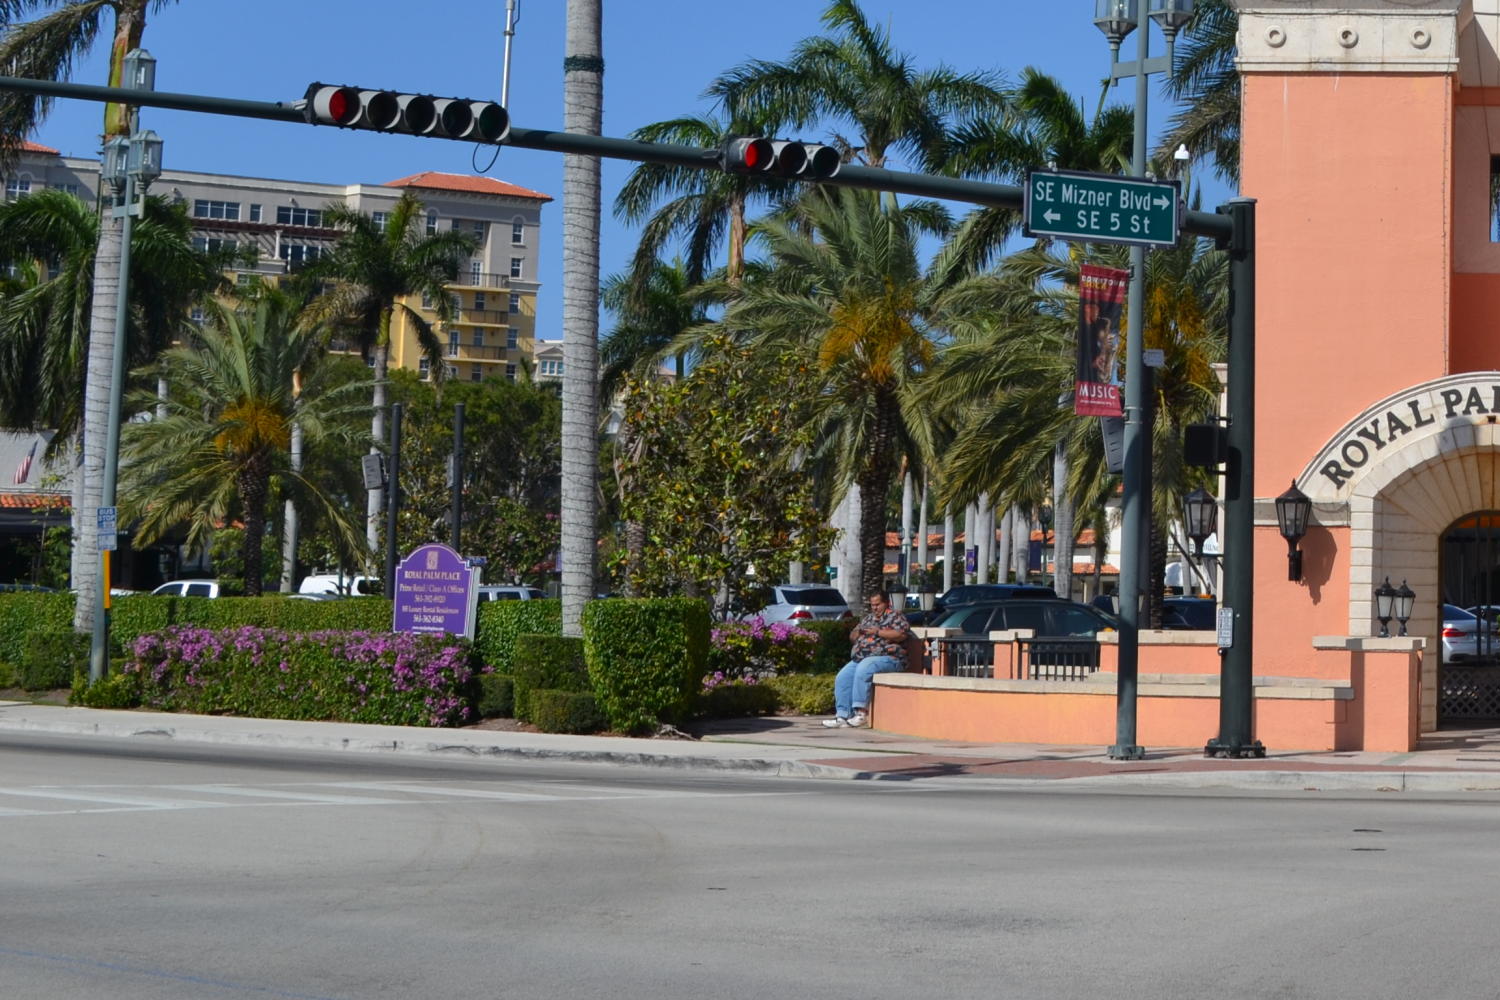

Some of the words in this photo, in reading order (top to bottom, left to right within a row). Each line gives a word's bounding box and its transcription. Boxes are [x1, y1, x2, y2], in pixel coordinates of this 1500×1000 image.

[1035, 181, 1055, 202] SE
[1061, 183, 1112, 207] Mizner
[1120, 189, 1151, 211] Blvd
[1077, 210, 1100, 230] SE
[1110, 213, 1120, 231] 5
[1130, 215, 1150, 234] St
[1079, 383, 1116, 399] MUSIC
[1320, 400, 1435, 490] ROYAL
[405, 571, 422, 579] ROYAL
[424, 571, 441, 580] PALM
[442, 572, 460, 580] PLACE
